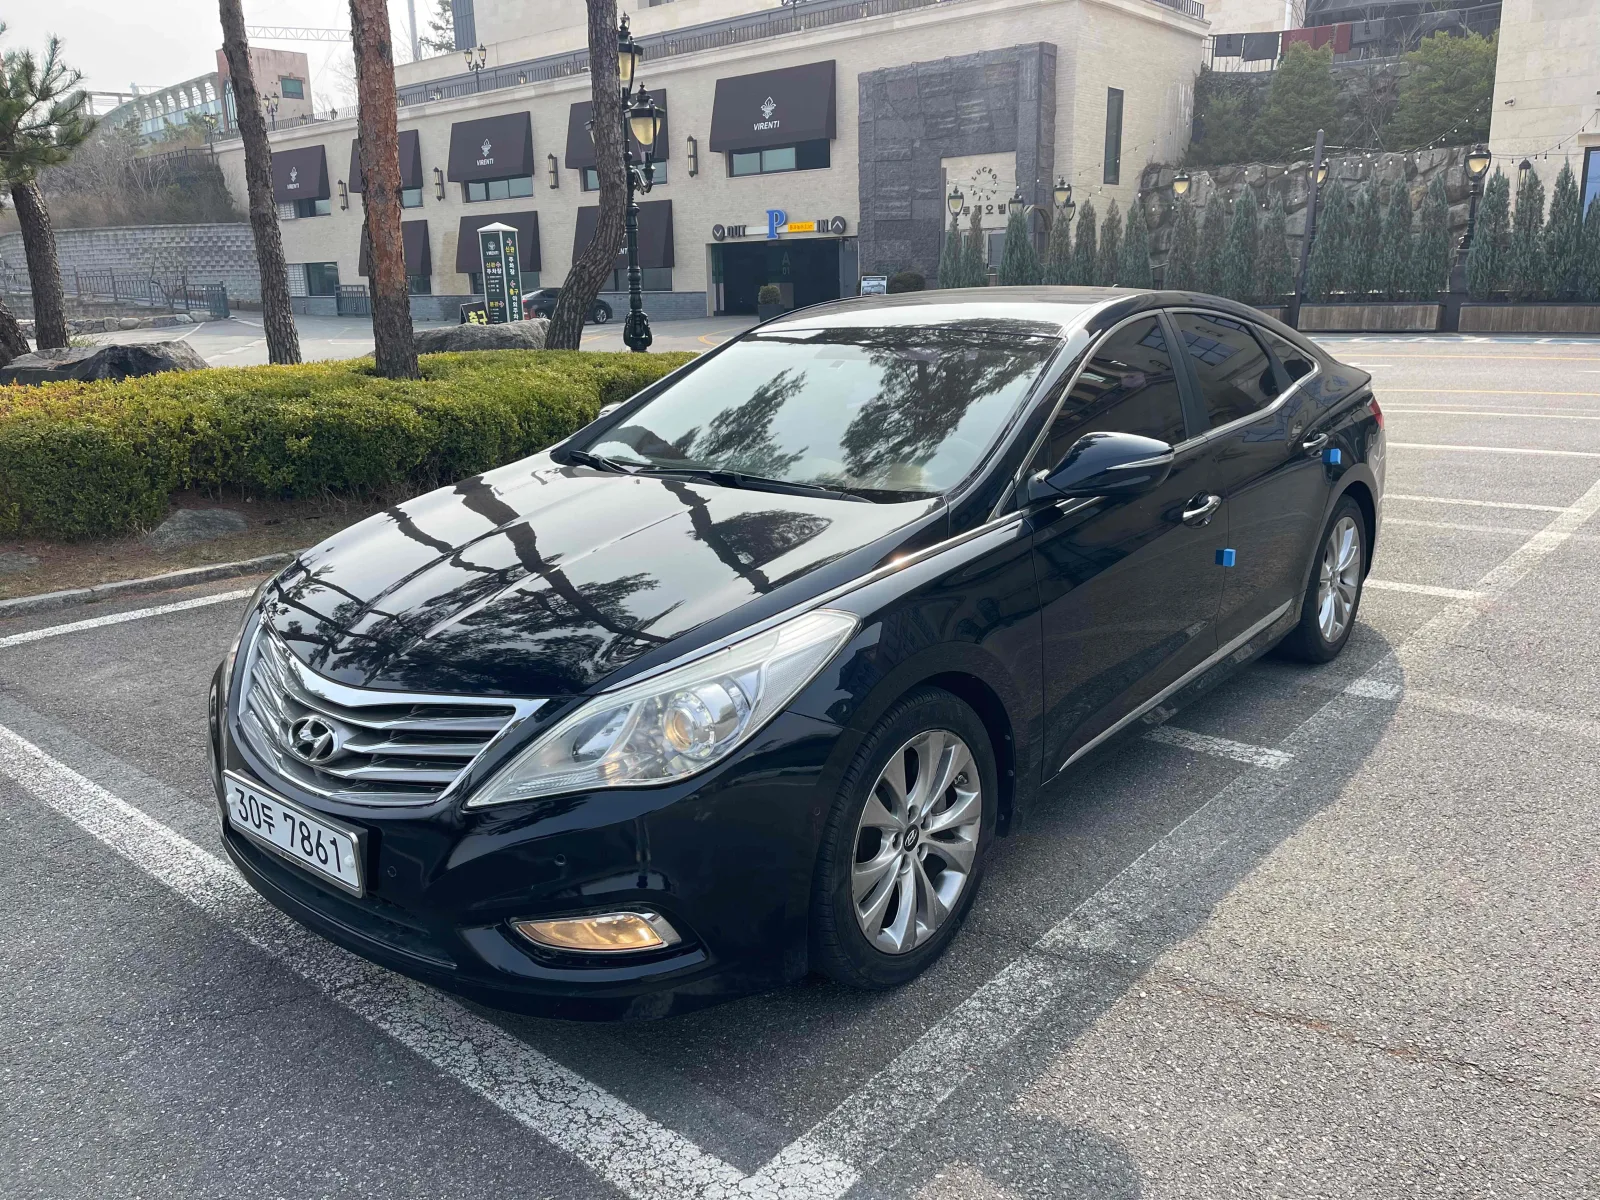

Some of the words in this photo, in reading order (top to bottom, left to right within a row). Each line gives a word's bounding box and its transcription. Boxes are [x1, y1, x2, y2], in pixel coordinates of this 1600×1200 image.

[753, 120, 780, 131] VIRENTI
[727, 224, 747, 237] OUT
[766, 209, 787, 239] P
[816, 219, 828, 233] IN
[468, 310, 488, 326] 출구
[235, 787, 276, 835] 30두
[283, 812, 341, 873] 7861
